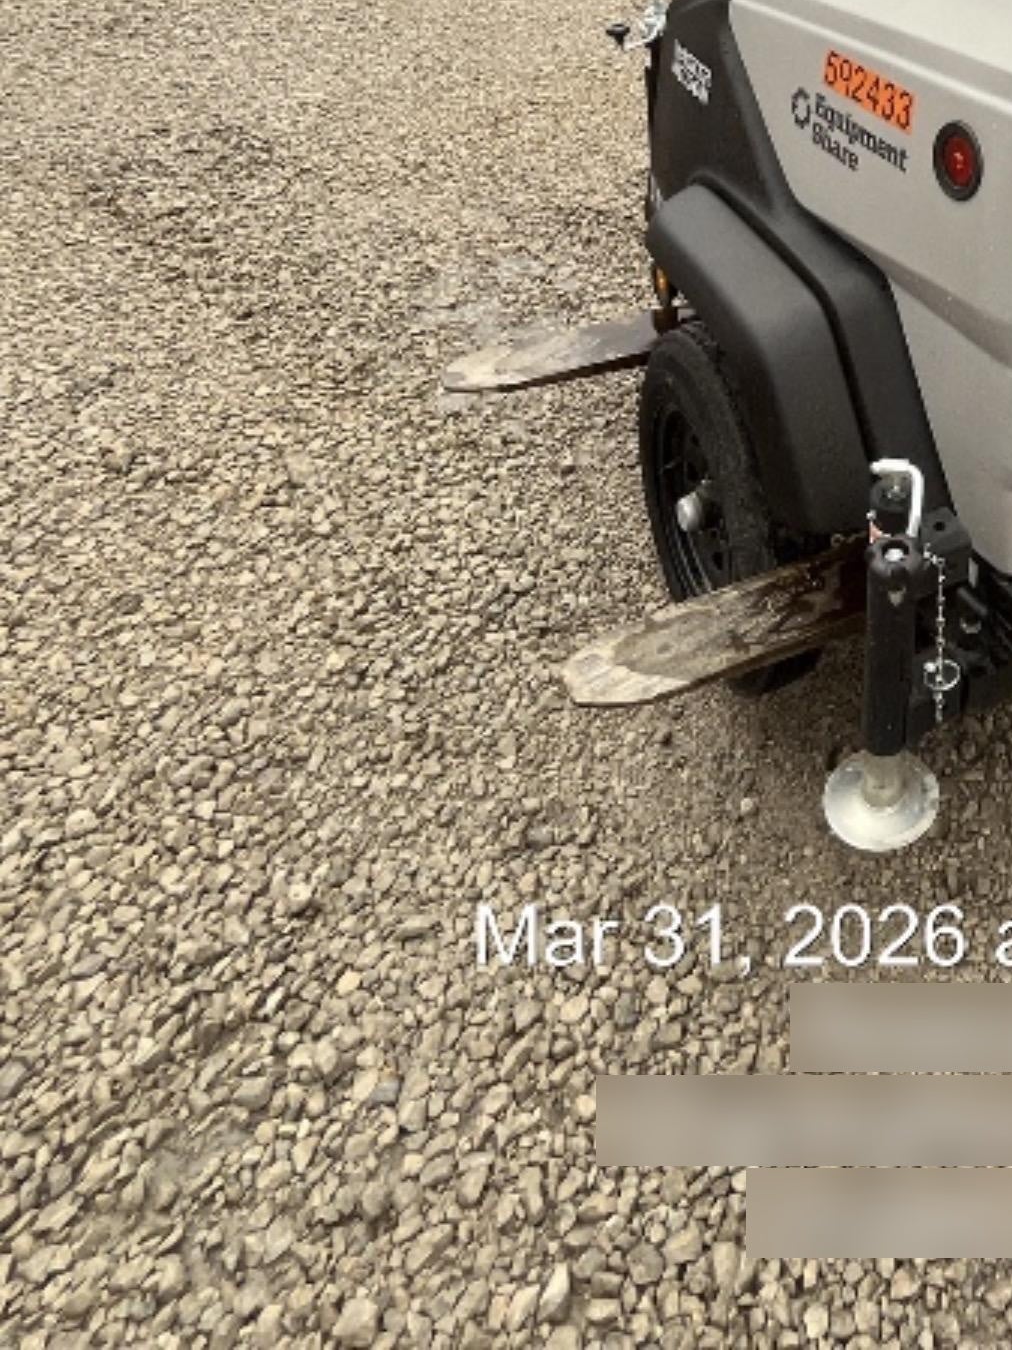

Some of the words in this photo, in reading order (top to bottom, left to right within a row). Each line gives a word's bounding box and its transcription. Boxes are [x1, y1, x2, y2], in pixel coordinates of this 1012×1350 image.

[824, 48, 915, 132] 592433
[811, 121, 860, 172] Share
[813, 91, 909, 173] Equipment
